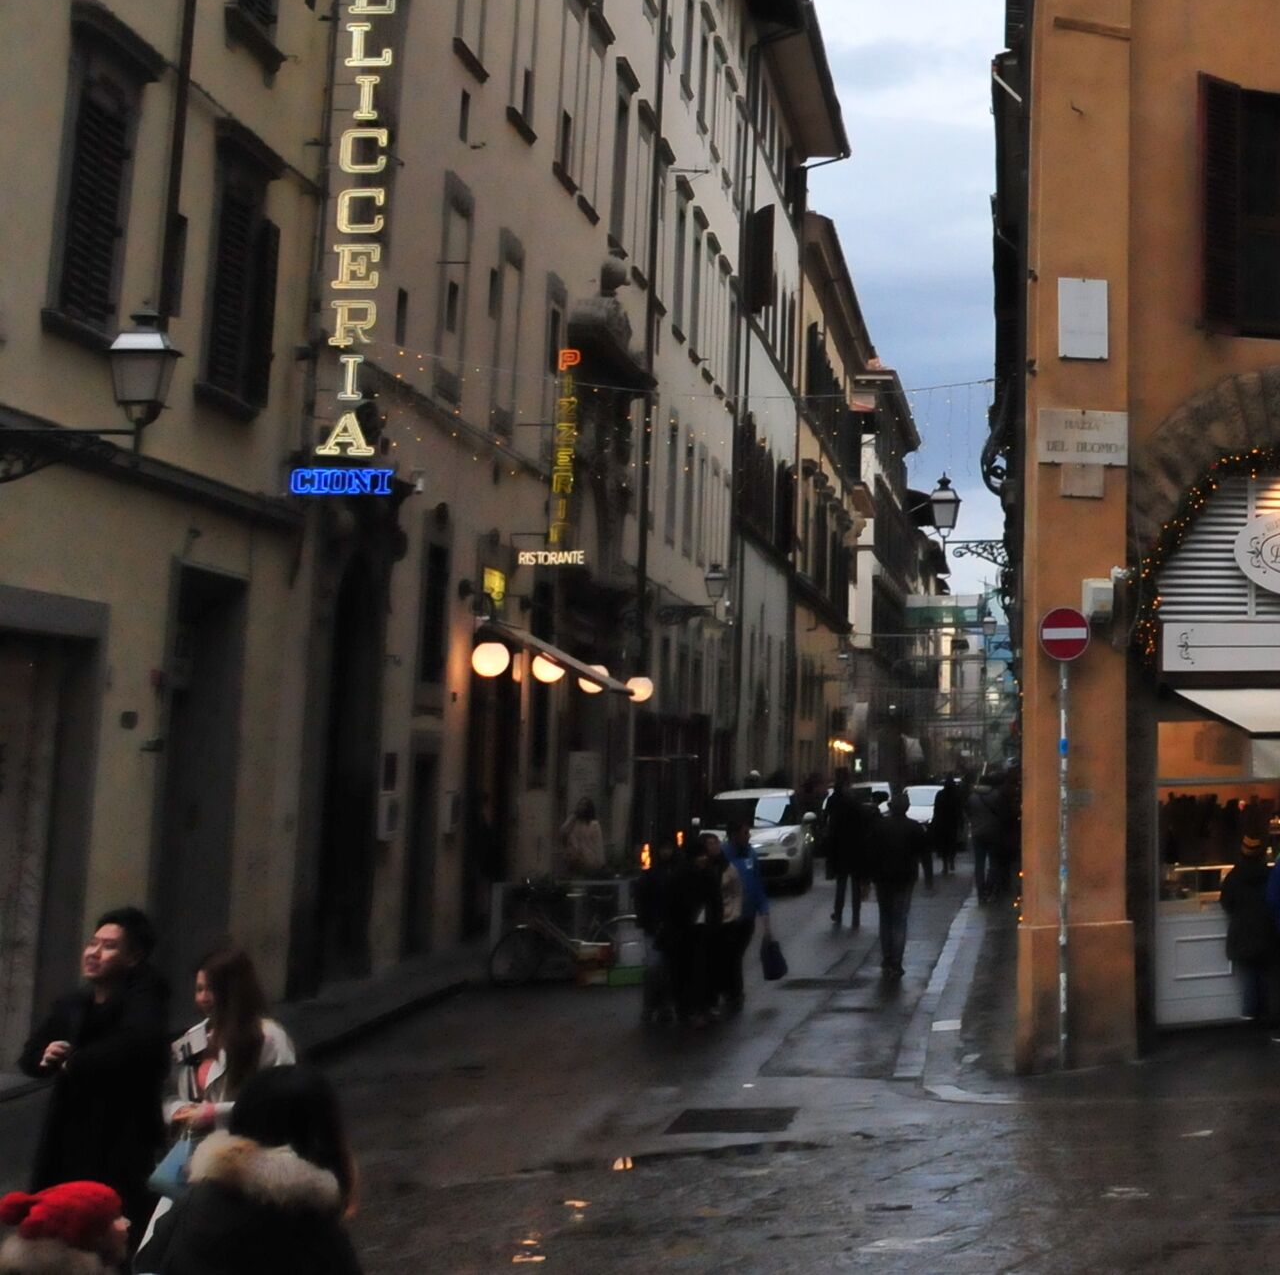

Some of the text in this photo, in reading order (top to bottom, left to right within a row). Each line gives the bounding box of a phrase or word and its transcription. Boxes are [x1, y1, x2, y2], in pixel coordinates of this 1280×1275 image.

[1046, 440, 1119, 454] DEL DUOMO
[290, 467, 395, 495] CIONI
[517, 549, 585, 565] RISTORANTE
